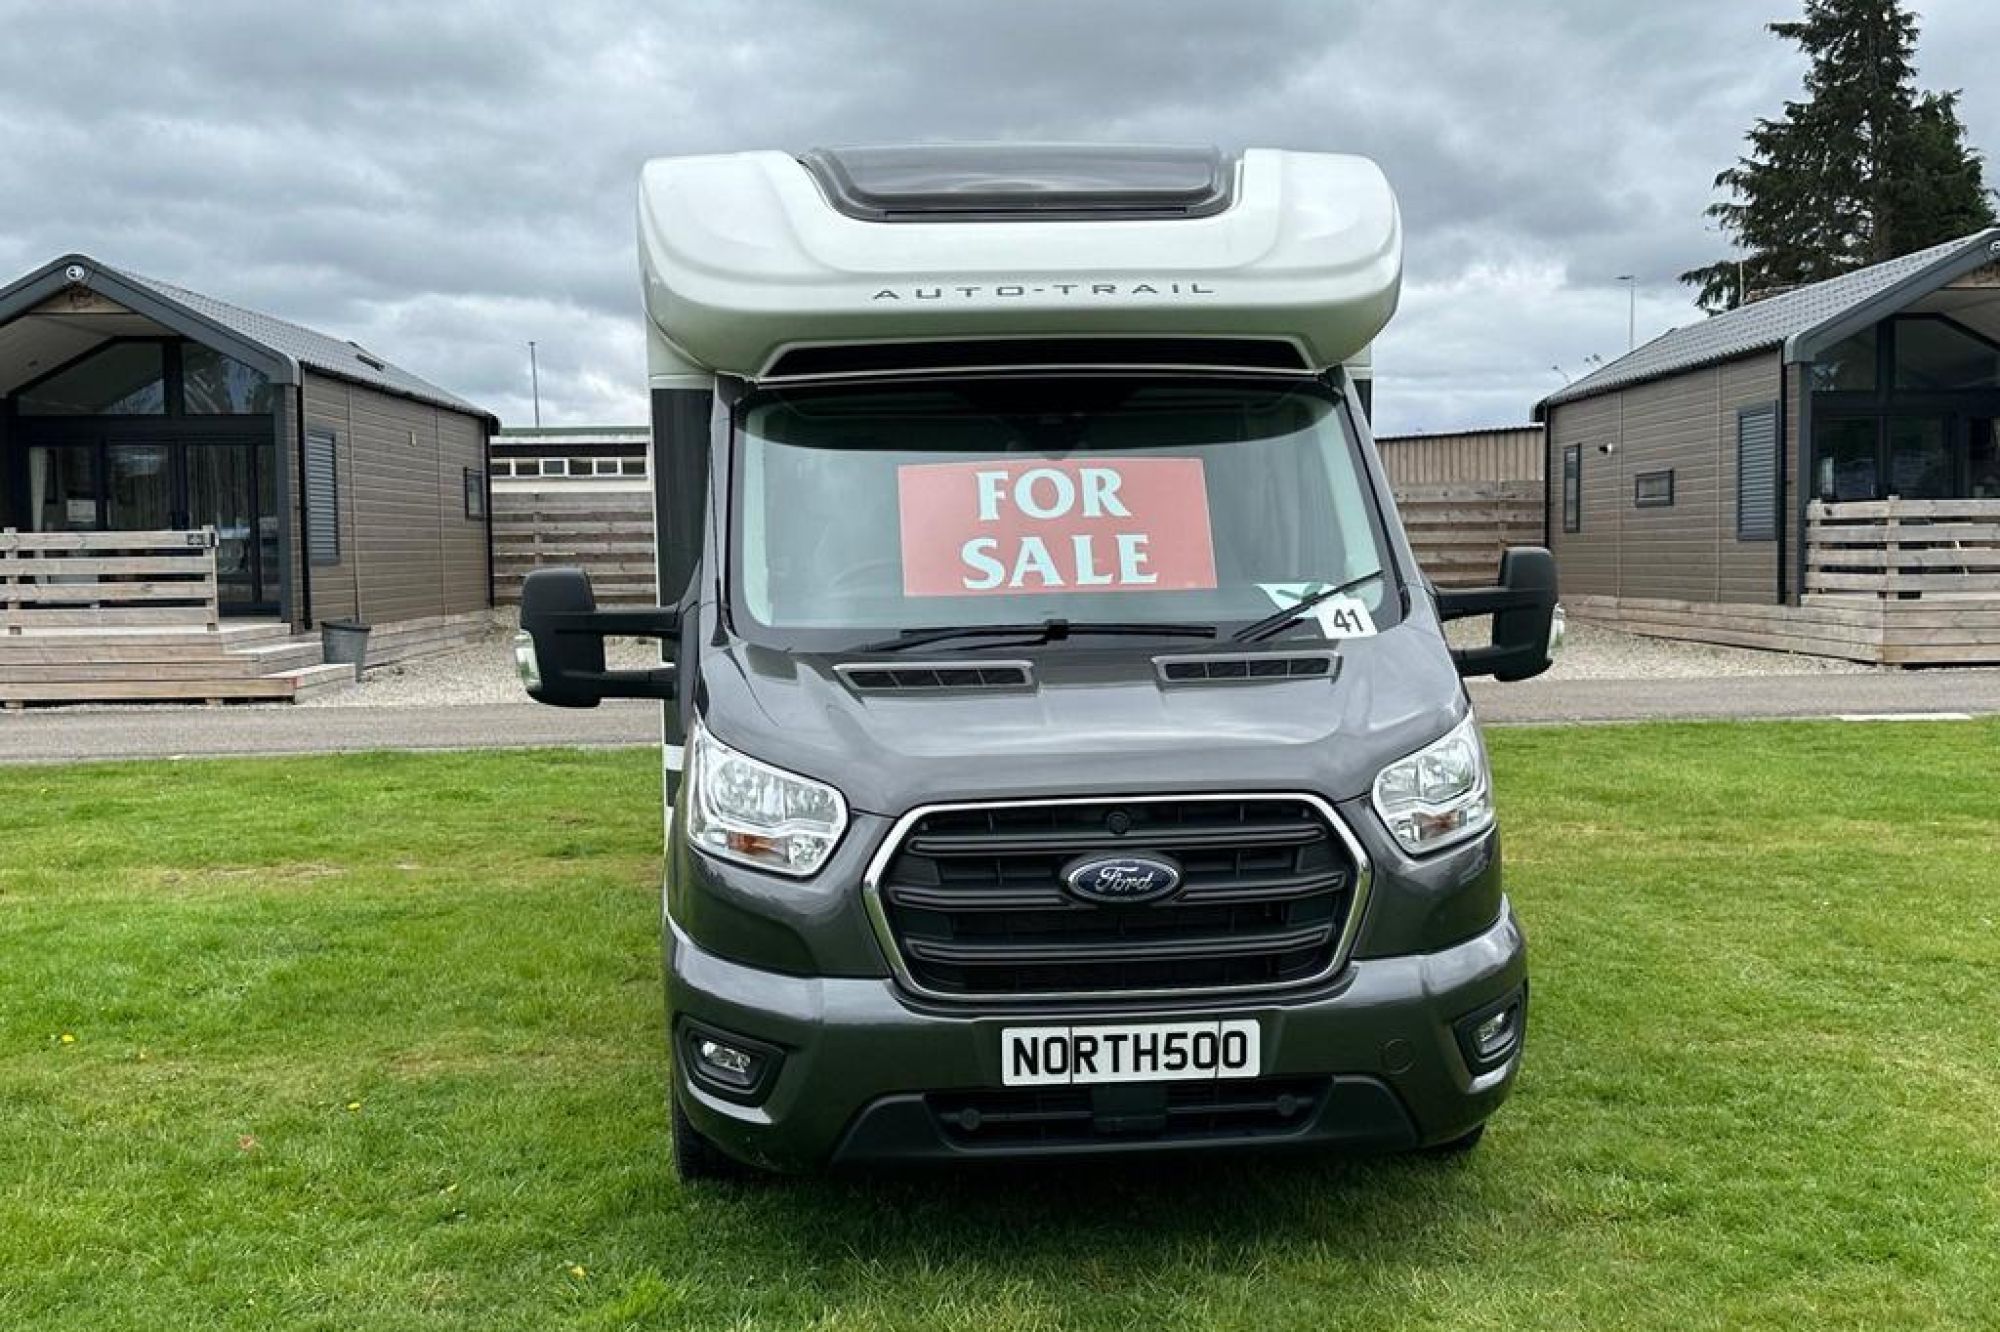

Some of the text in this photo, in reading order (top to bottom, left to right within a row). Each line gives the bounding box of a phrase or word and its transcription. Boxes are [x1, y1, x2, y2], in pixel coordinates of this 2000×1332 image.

[873, 282, 1215, 300] AUTO-TRAIL
[975, 467, 1131, 521] FOR
[961, 534, 1158, 589] SALE
[1333, 608, 1364, 633] 41
[1095, 866, 1154, 892] Ford
[1012, 1030, 1248, 1076] NORTH500
